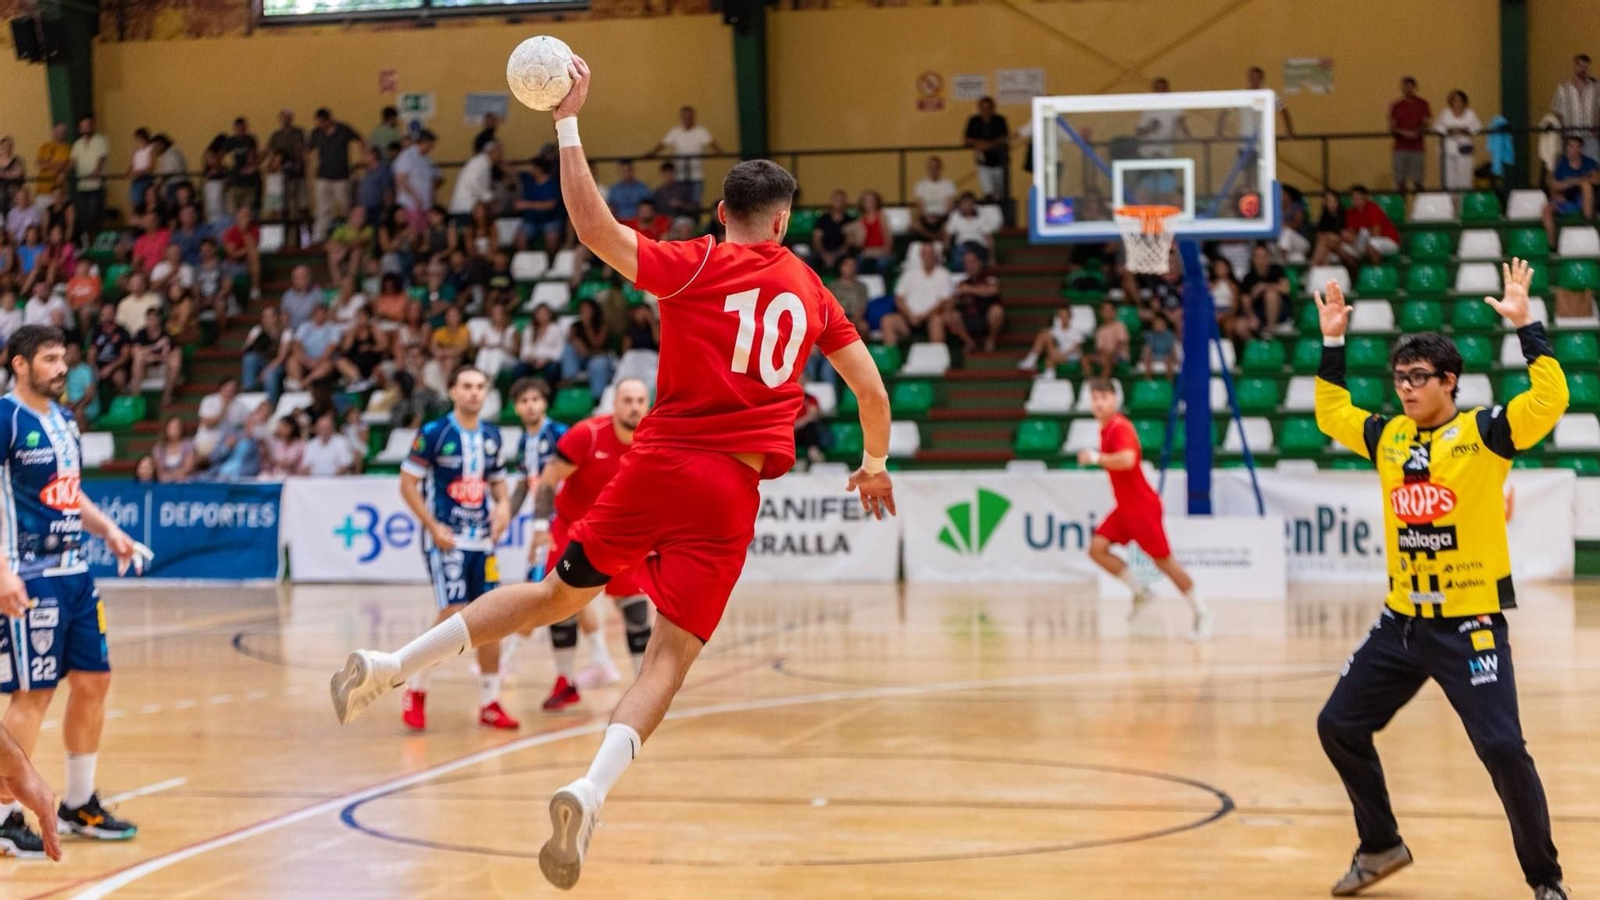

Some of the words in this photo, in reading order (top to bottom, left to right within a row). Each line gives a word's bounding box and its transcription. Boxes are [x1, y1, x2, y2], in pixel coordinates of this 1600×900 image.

[724, 287, 807, 389] 10
[1391, 484, 1454, 517] TROPS
[160, 501, 275, 528] DEPORTES
[1399, 528, 1453, 551] málaga
[31, 655, 57, 681] 22
[1468, 653, 1498, 676] HW
